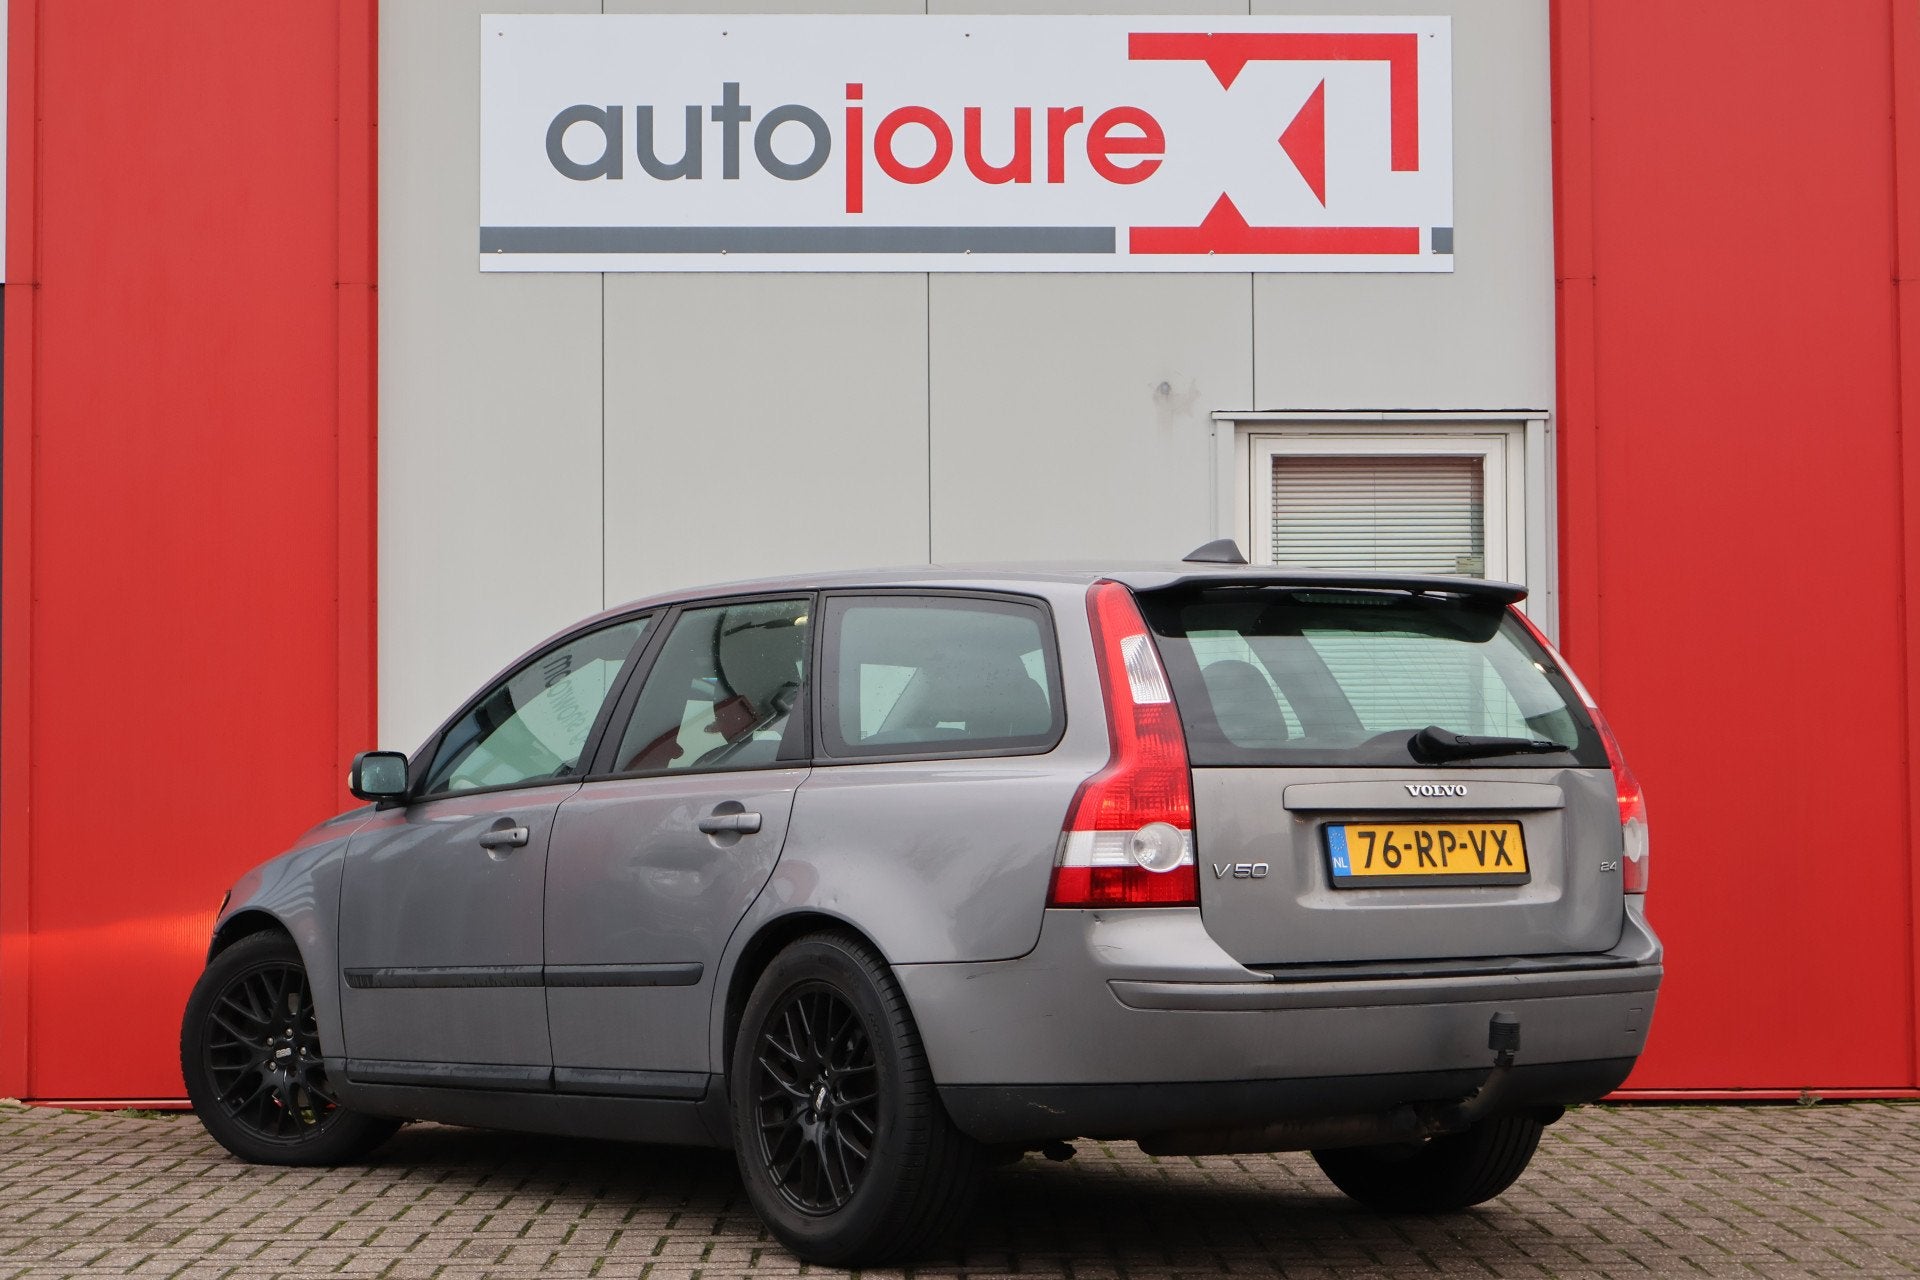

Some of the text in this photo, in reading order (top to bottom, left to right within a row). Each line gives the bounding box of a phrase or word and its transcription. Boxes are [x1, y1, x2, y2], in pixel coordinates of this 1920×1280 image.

[1405, 785, 1467, 797] VOLVO
[1358, 830, 1512, 868] 76-RP-VX
[1333, 857, 1348, 868] NL
